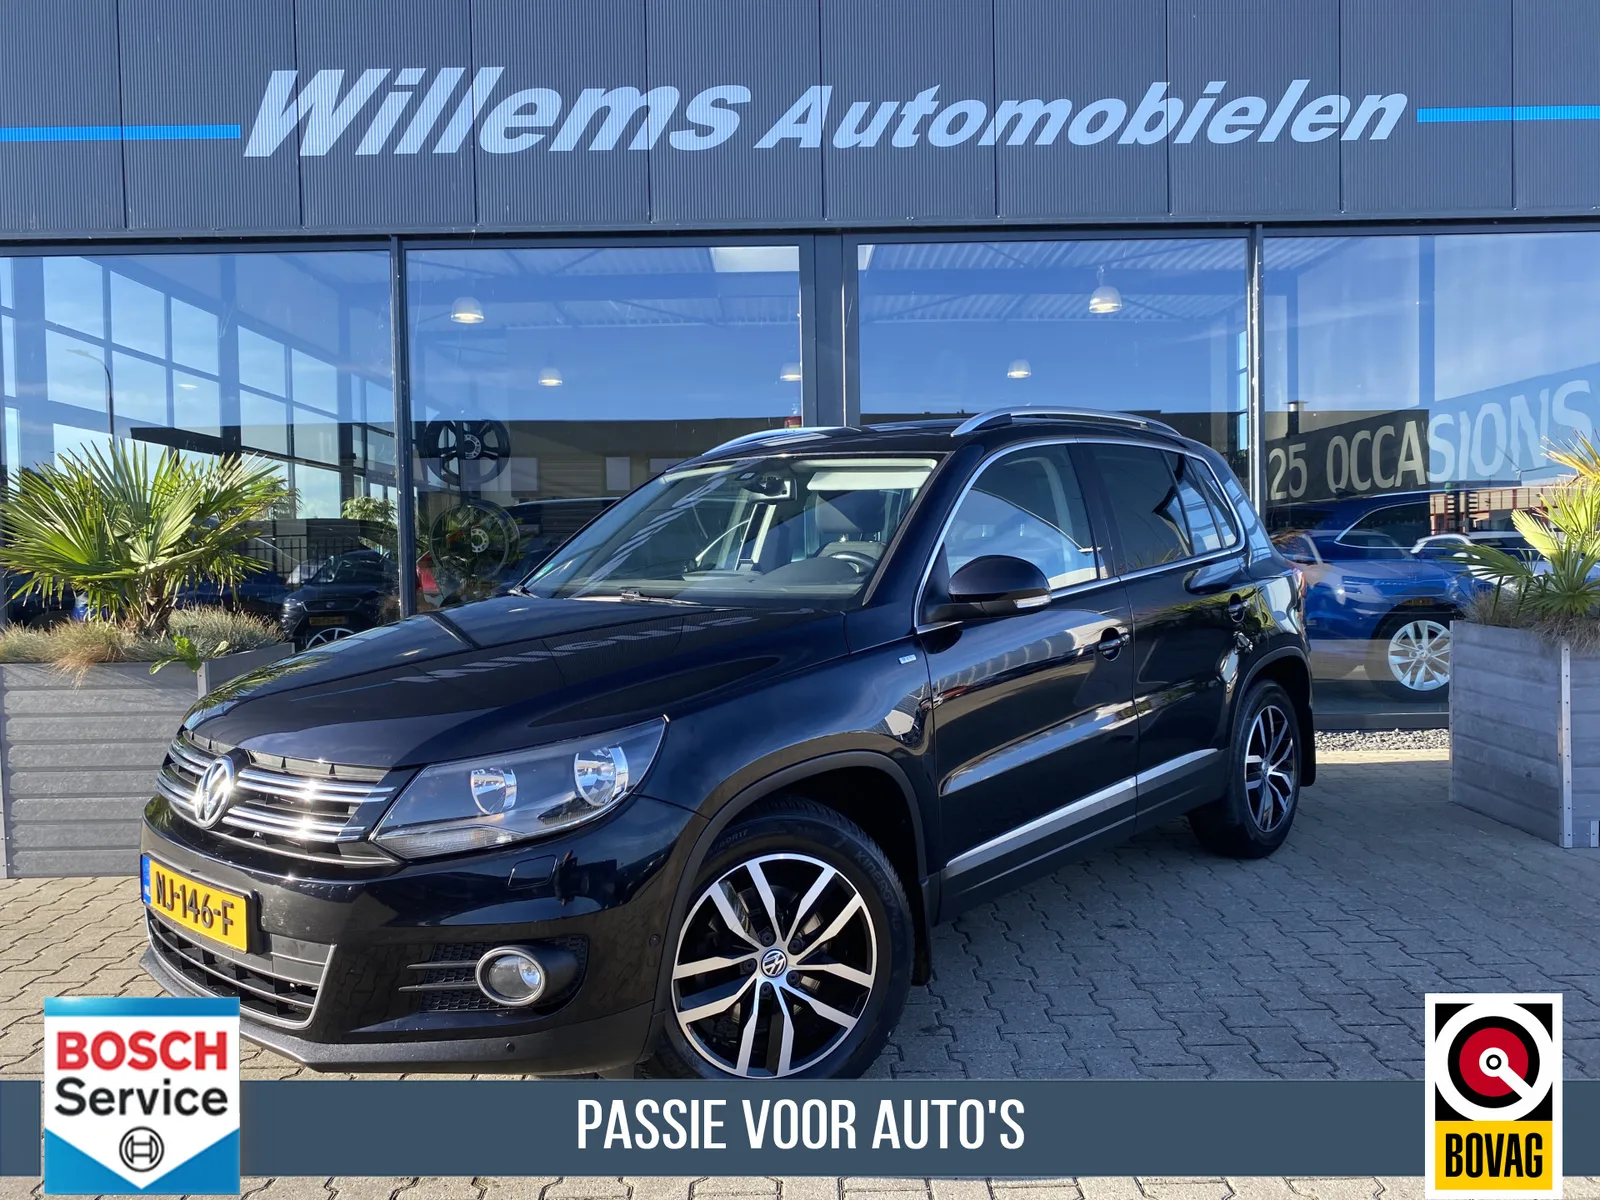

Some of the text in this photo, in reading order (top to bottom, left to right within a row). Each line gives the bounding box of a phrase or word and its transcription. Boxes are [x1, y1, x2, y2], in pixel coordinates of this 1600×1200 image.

[243, 66, 1408, 158] Willems Automobielen
[1268, 379, 1593, 501] 25 OCCASIONS
[155, 871, 235, 936] NJ-146-F
